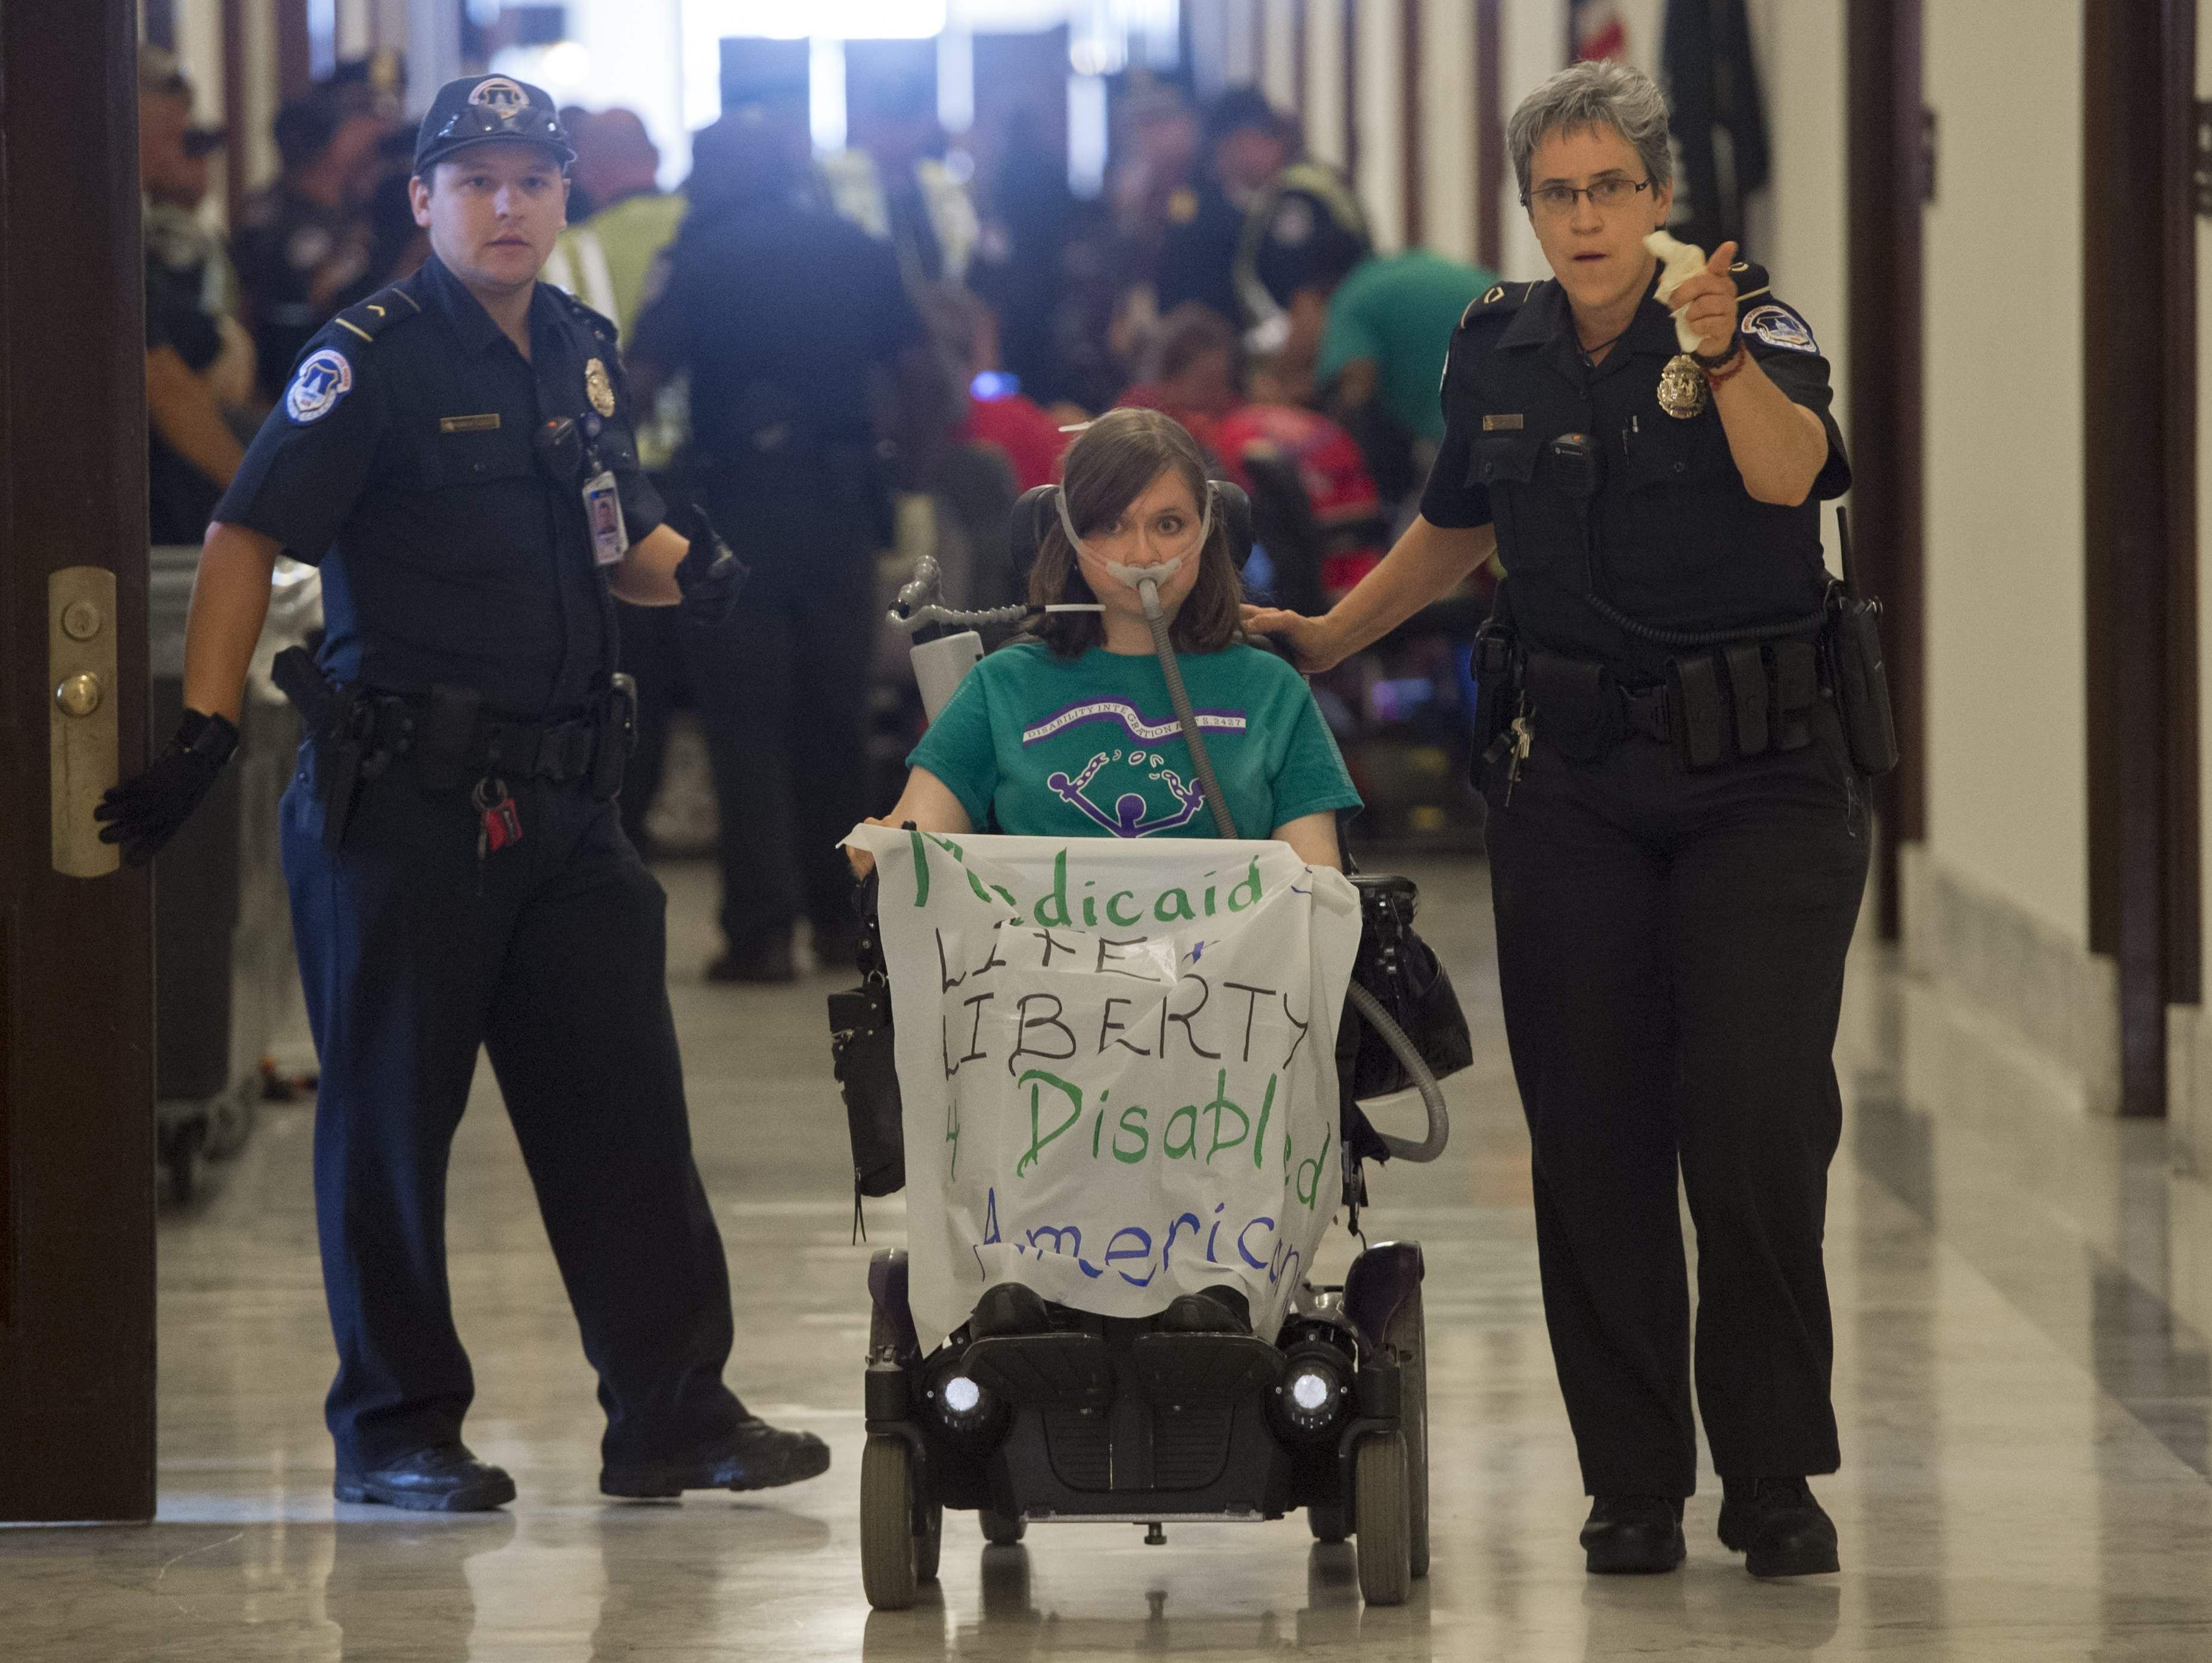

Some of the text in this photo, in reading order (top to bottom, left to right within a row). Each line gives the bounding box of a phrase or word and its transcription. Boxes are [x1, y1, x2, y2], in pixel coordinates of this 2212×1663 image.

[1028, 707, 1094, 738] DISABILITY
[1098, 704, 1171, 737] INTEGRATION
[942, 974, 1310, 1081] LIBERTY
